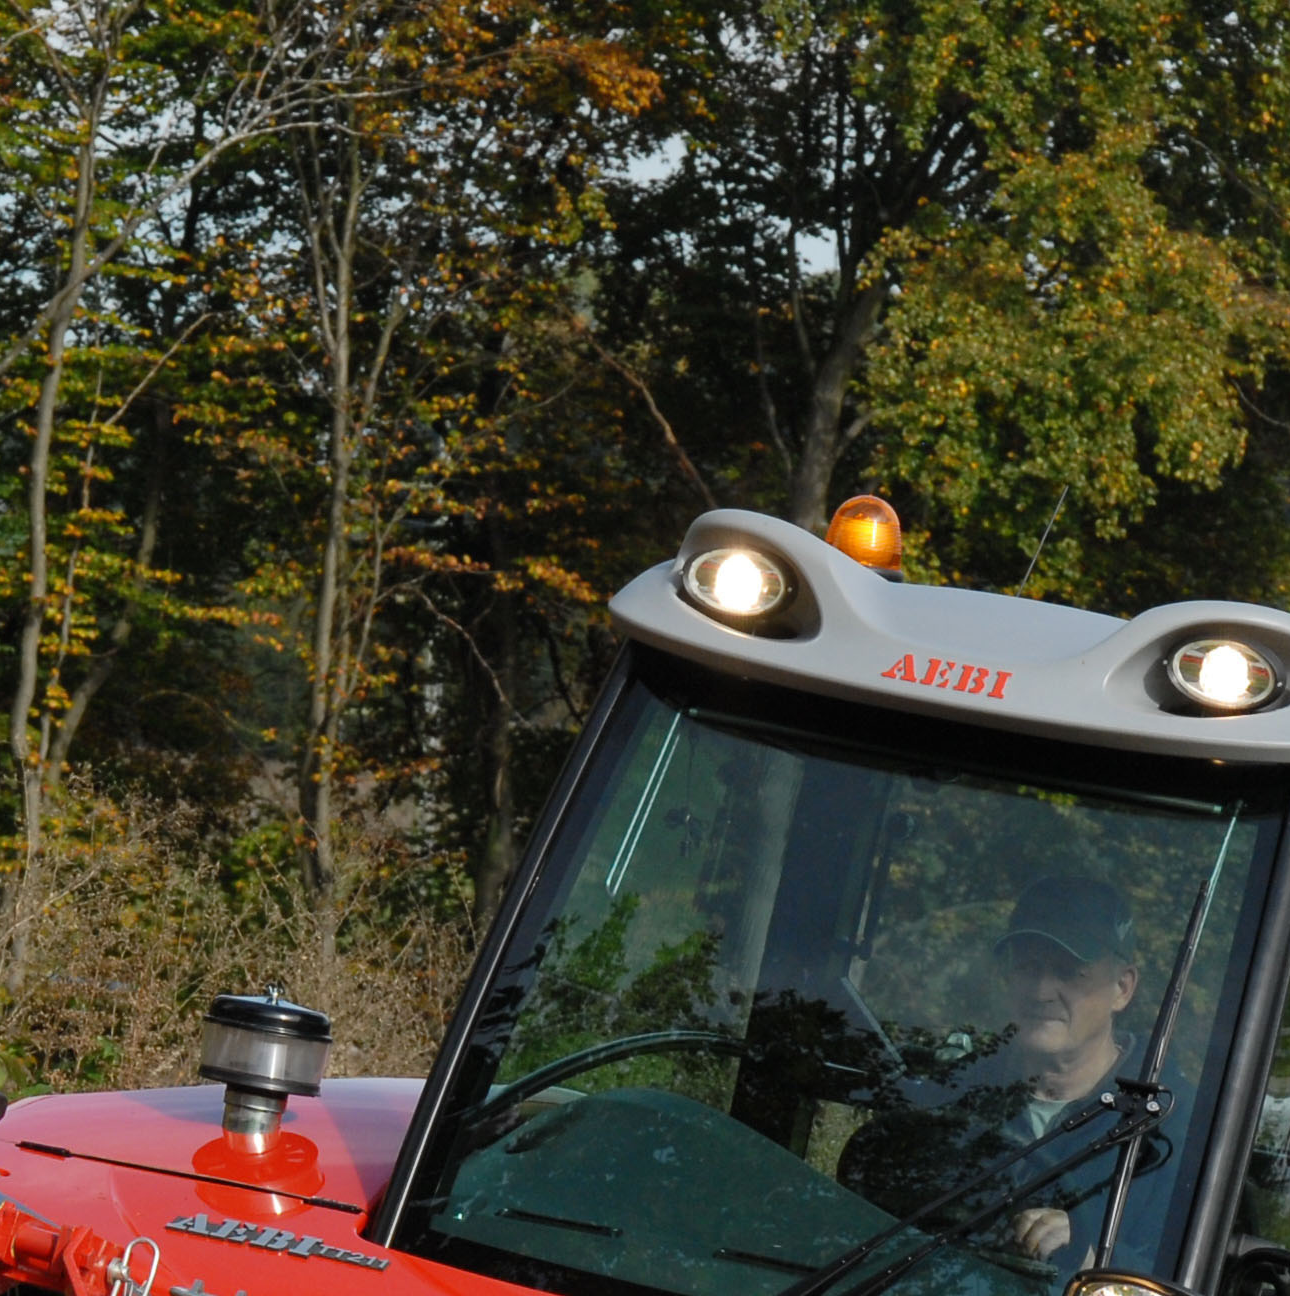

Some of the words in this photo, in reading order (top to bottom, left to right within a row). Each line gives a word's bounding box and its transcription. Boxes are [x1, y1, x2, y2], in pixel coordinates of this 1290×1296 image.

[880, 653, 1013, 699] AEBI
[166, 1213, 323, 1257] AEBI
[320, 1244, 391, 1270] TT211
